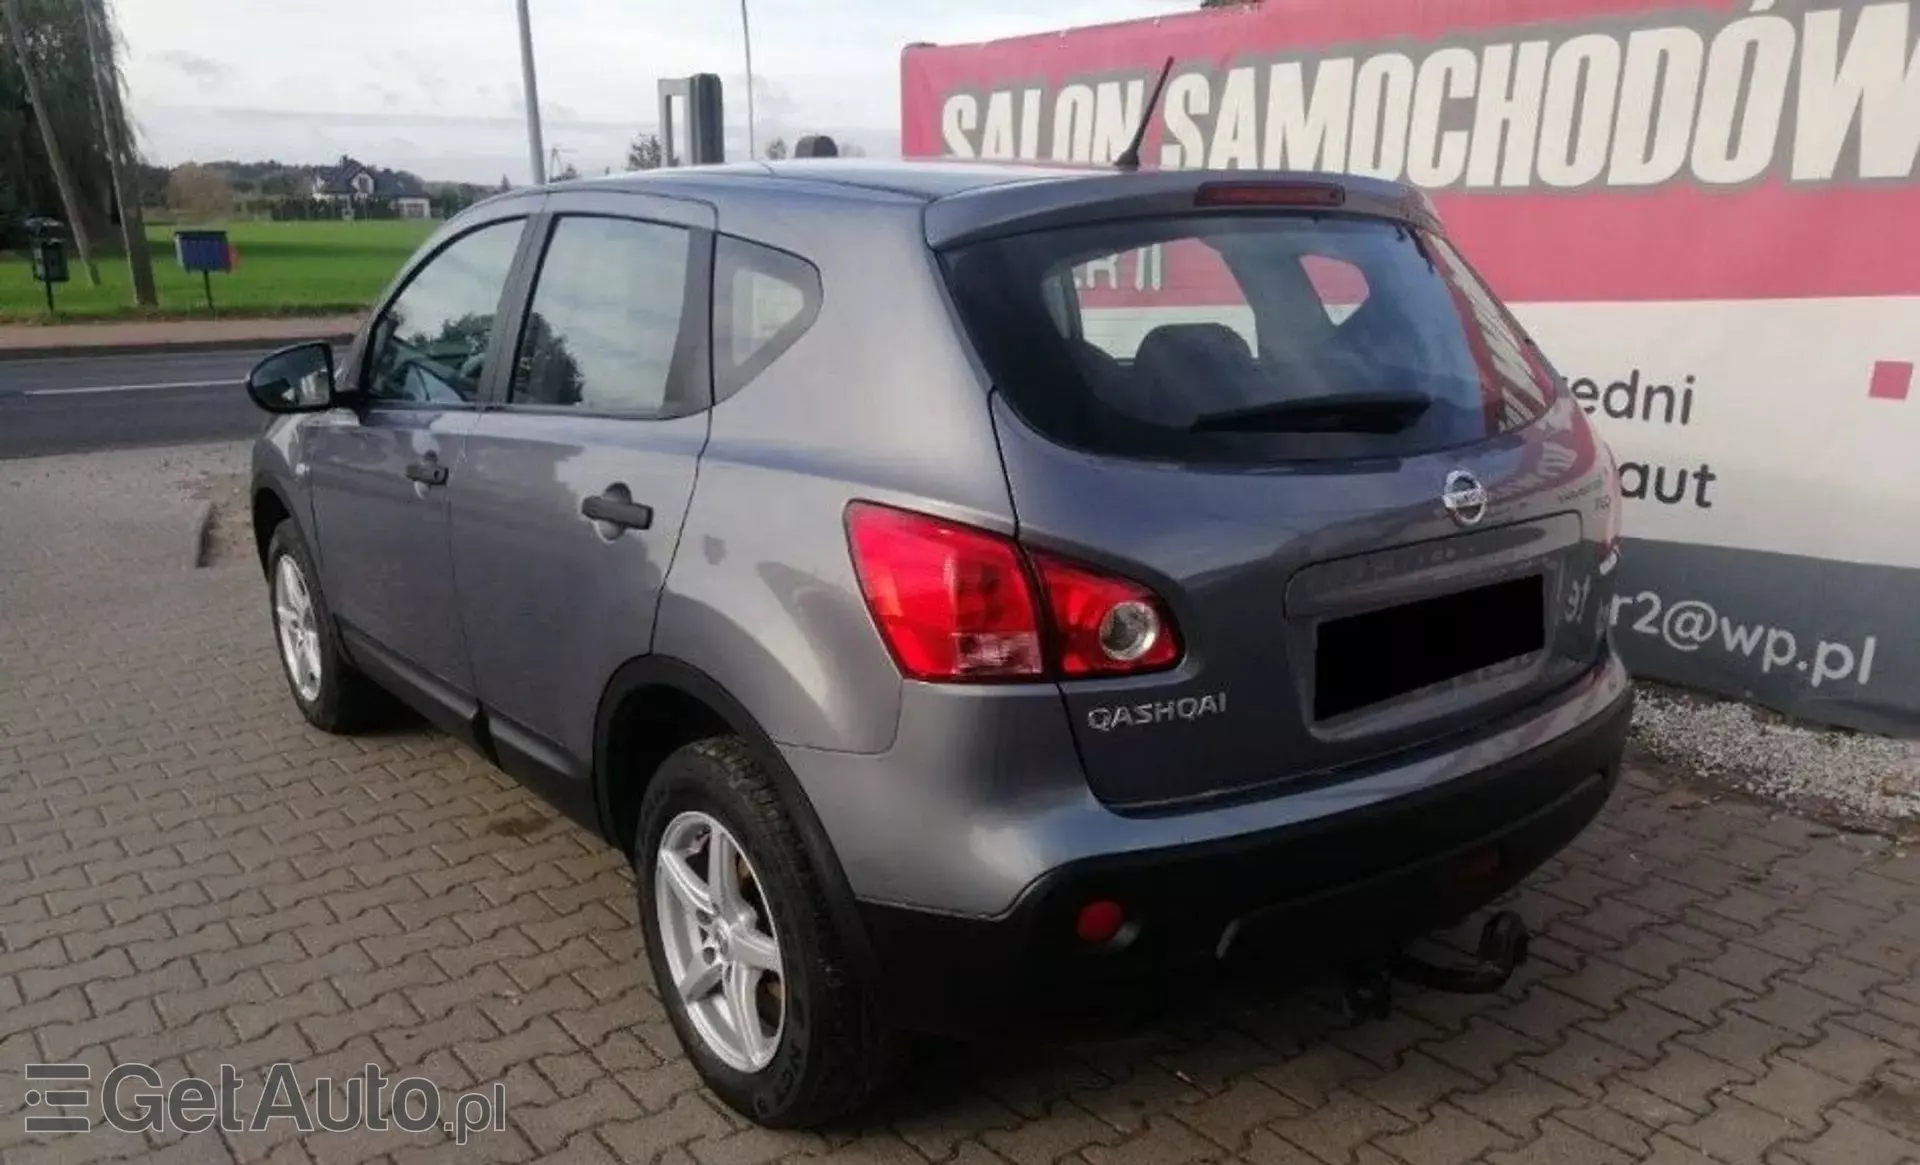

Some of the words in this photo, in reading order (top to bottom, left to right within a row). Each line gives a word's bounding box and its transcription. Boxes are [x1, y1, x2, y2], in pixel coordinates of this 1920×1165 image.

[942, 78, 1147, 165] SALON
[1160, 0, 1920, 188] SAMOCHODÓW
[1561, 368, 1696, 425] edni
[1618, 461, 1717, 508] aut
[1609, 590, 1876, 687] r2@wp.pl
[1087, 691, 1227, 732] QASHQAI
